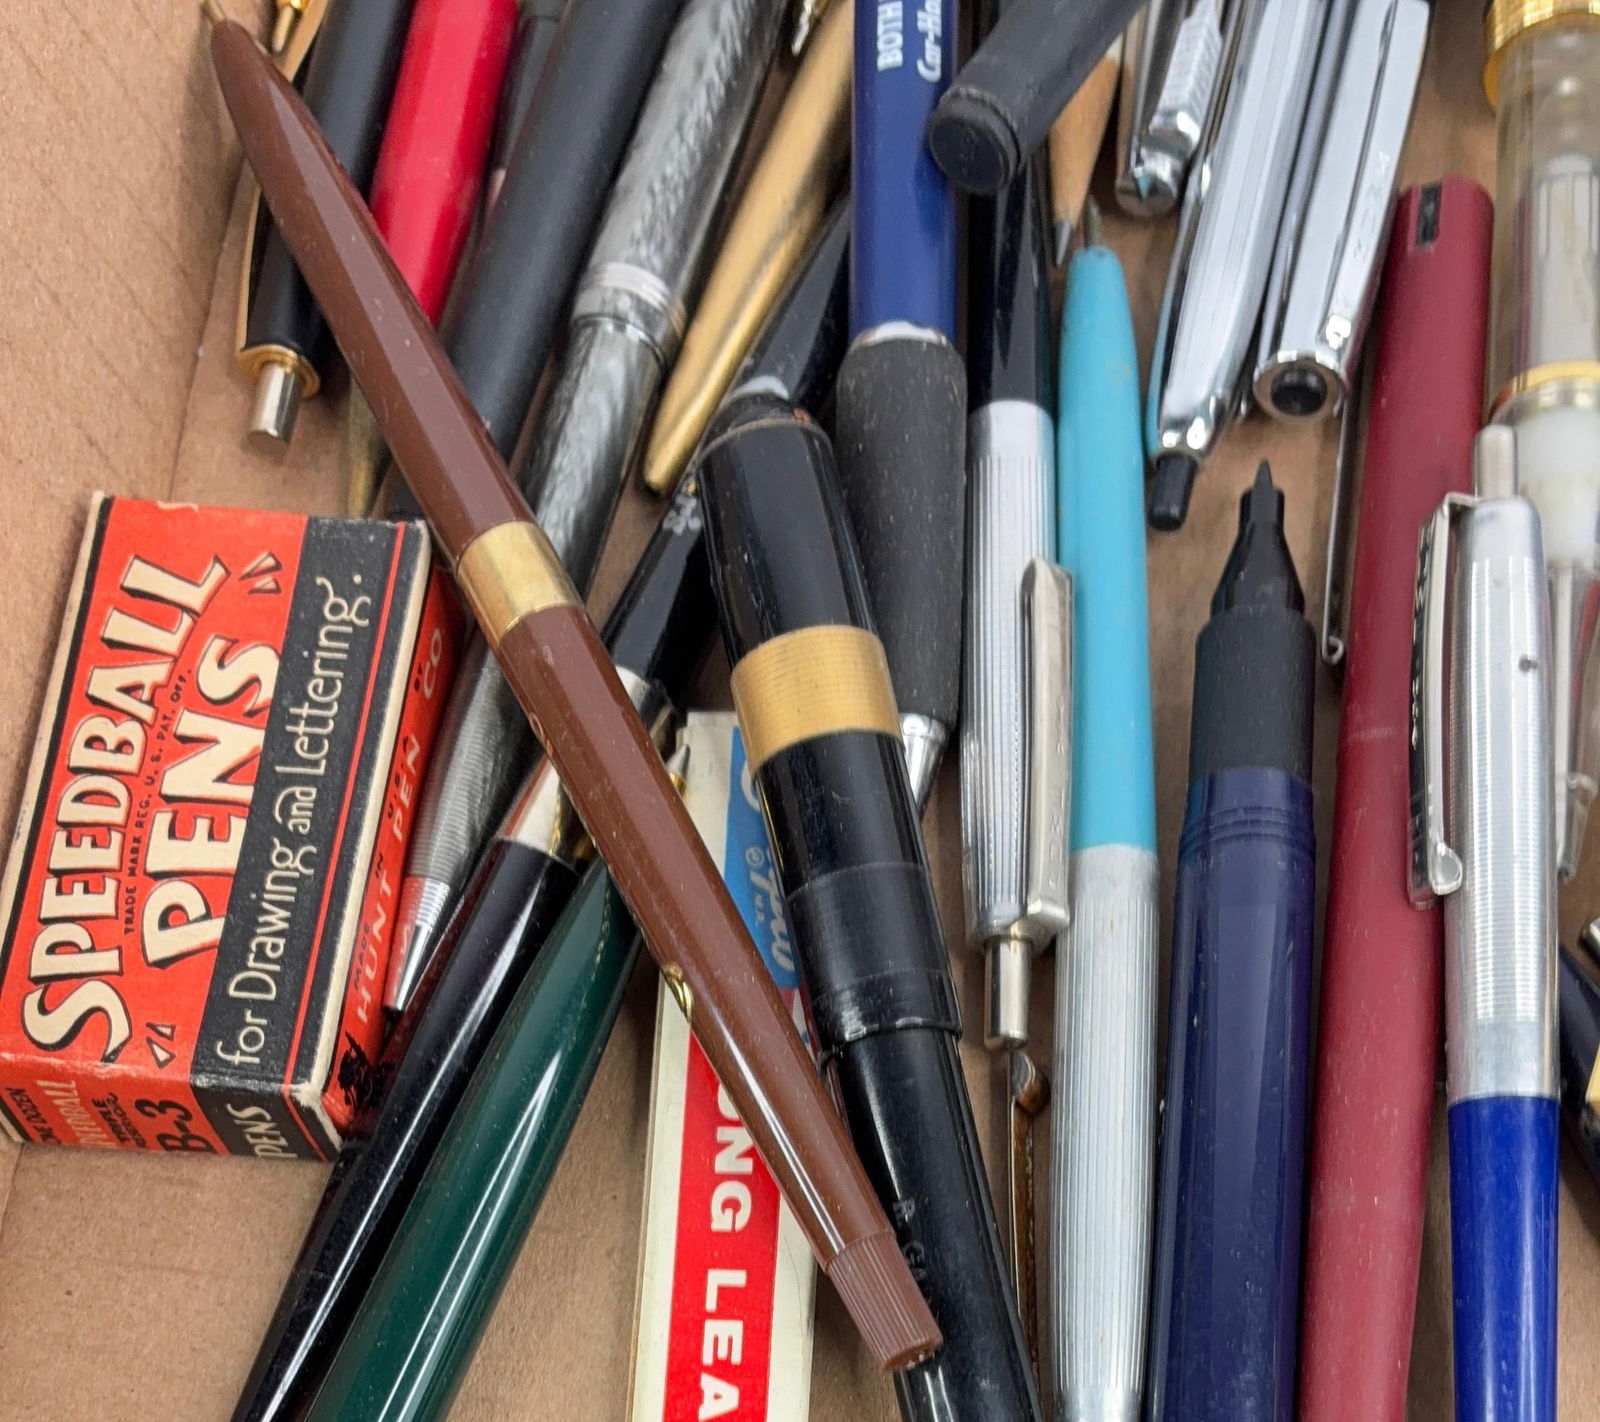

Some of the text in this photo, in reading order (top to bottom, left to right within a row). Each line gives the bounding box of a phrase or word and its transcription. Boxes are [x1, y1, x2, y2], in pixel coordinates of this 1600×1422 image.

[877, 0, 903, 72] BOTH
[169, 668, 193, 703] OFF.
[156, 709, 176, 741] PAT.
[22, 554, 228, 1063] SPEEDBALL
[134, 793, 152, 829] REG.
[141, 634, 282, 968] PENS
[216, 573, 372, 1066] for Drawing and Lettering.
[127, 835, 143, 878] MARK
[357, 870, 393, 1024] HUNT
[392, 734, 421, 841] PEN
[123, 886, 137, 936] TRADE
[36, 1079, 119, 1148] PEEDBALL
[134, 1098, 214, 1151] B-3
[226, 1102, 299, 1159] PENS
